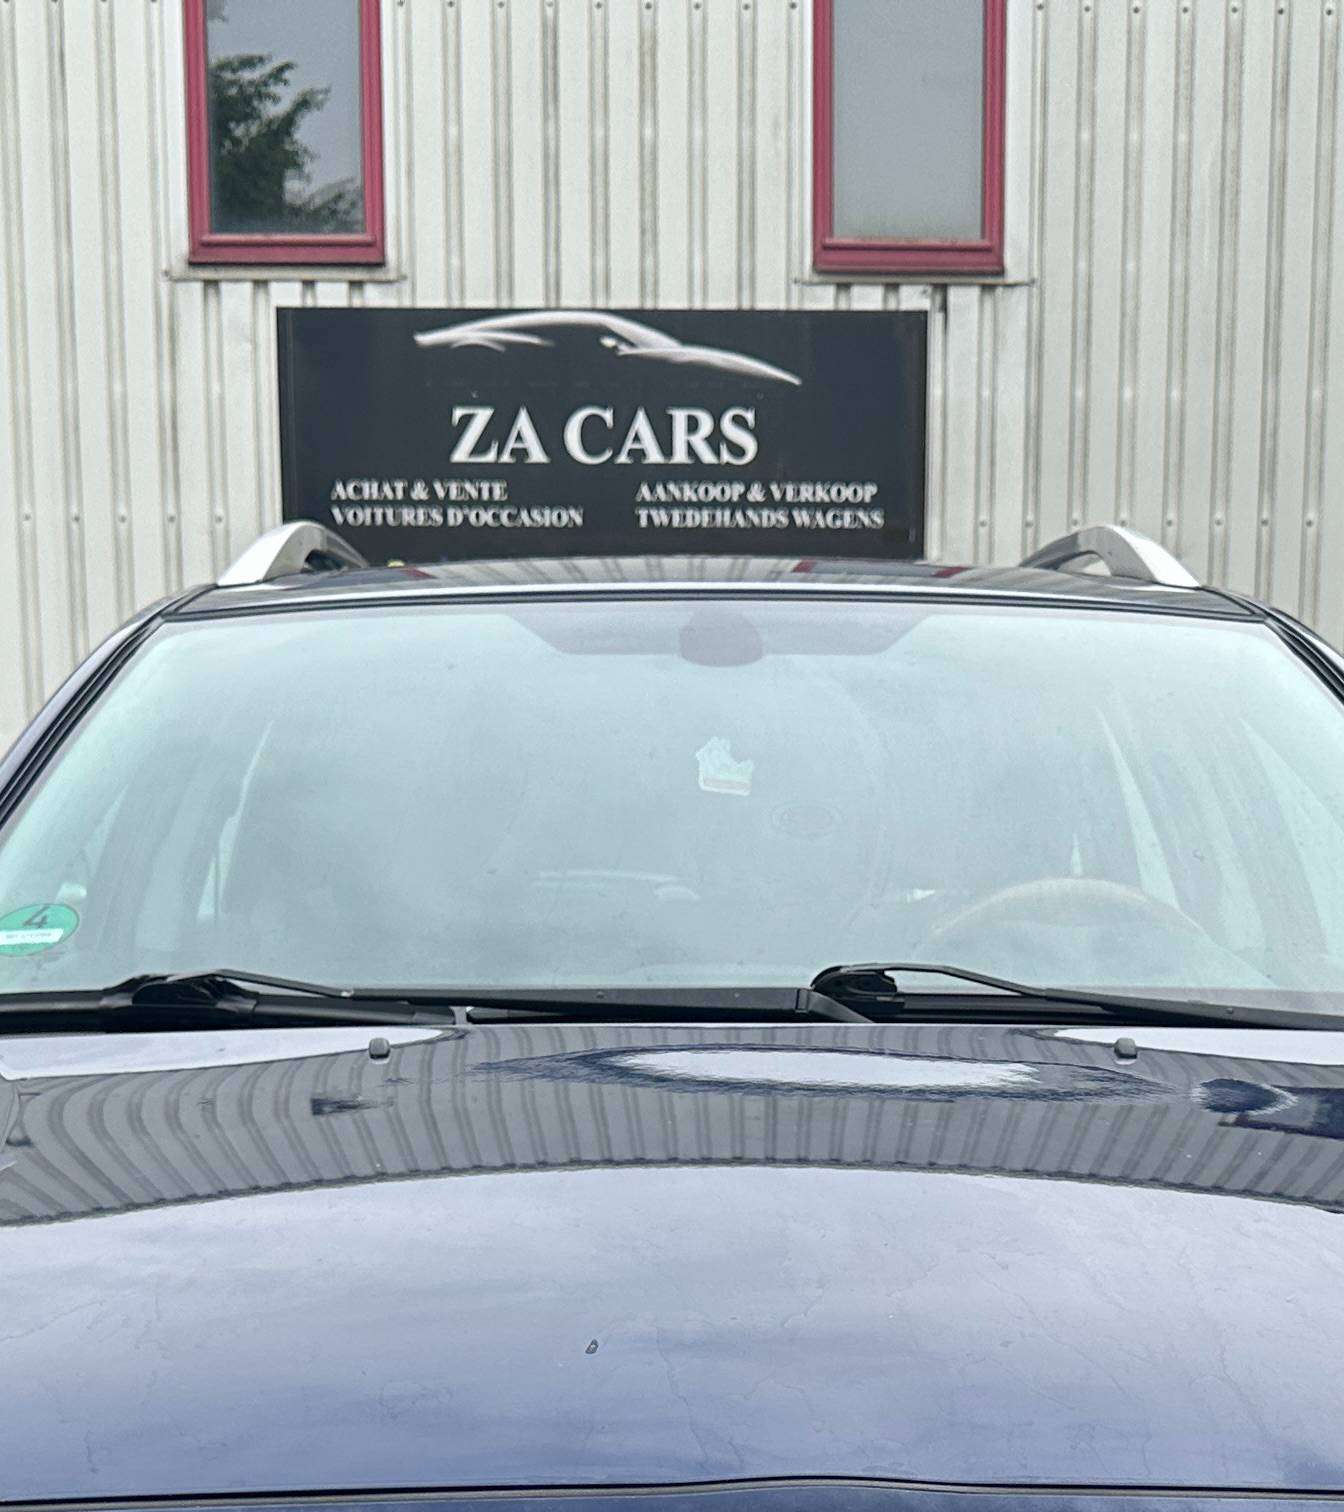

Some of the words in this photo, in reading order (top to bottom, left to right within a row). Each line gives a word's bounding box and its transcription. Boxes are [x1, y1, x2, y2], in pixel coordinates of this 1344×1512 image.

[451, 405, 550, 465] ZA
[562, 405, 758, 466] CARS
[331, 478, 407, 501] ACHAT
[410, 478, 429, 501] &
[432, 478, 508, 502] VENTE
[635, 480, 744, 503] AANKOOP
[746, 480, 766, 503] &
[769, 481, 878, 504] VERKOOP
[330, 505, 444, 527] VOITURES
[447, 505, 584, 528] D'OCCASION
[791, 507, 885, 530] WAGENS
